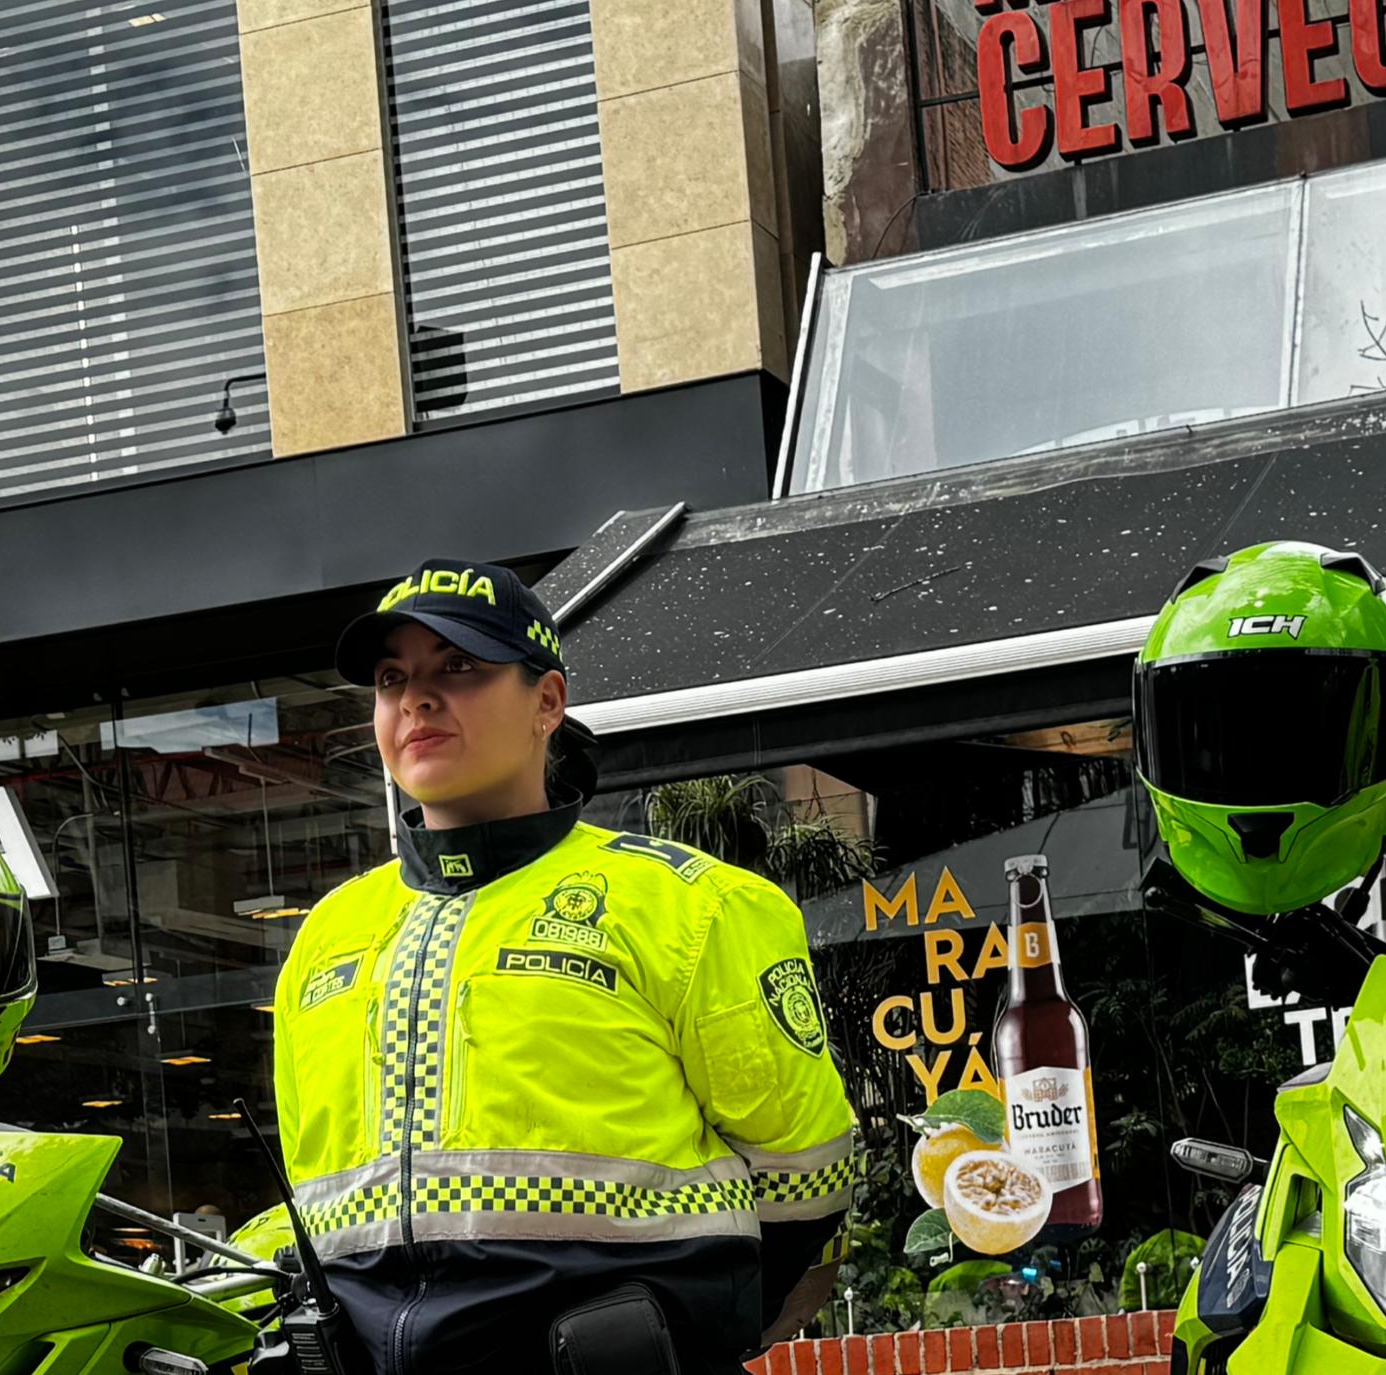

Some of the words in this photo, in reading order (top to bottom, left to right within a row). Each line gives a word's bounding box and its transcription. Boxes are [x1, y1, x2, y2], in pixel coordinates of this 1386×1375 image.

[863, 865, 977, 931] MA
[535, 921, 603, 948] 081988
[924, 921, 1011, 985] RA
[506, 953, 609, 987] POLICÍA
[872, 988, 967, 1051] CU
[905, 1031, 1006, 1108] YÁ
[1012, 1103, 1084, 1131] Bruder
